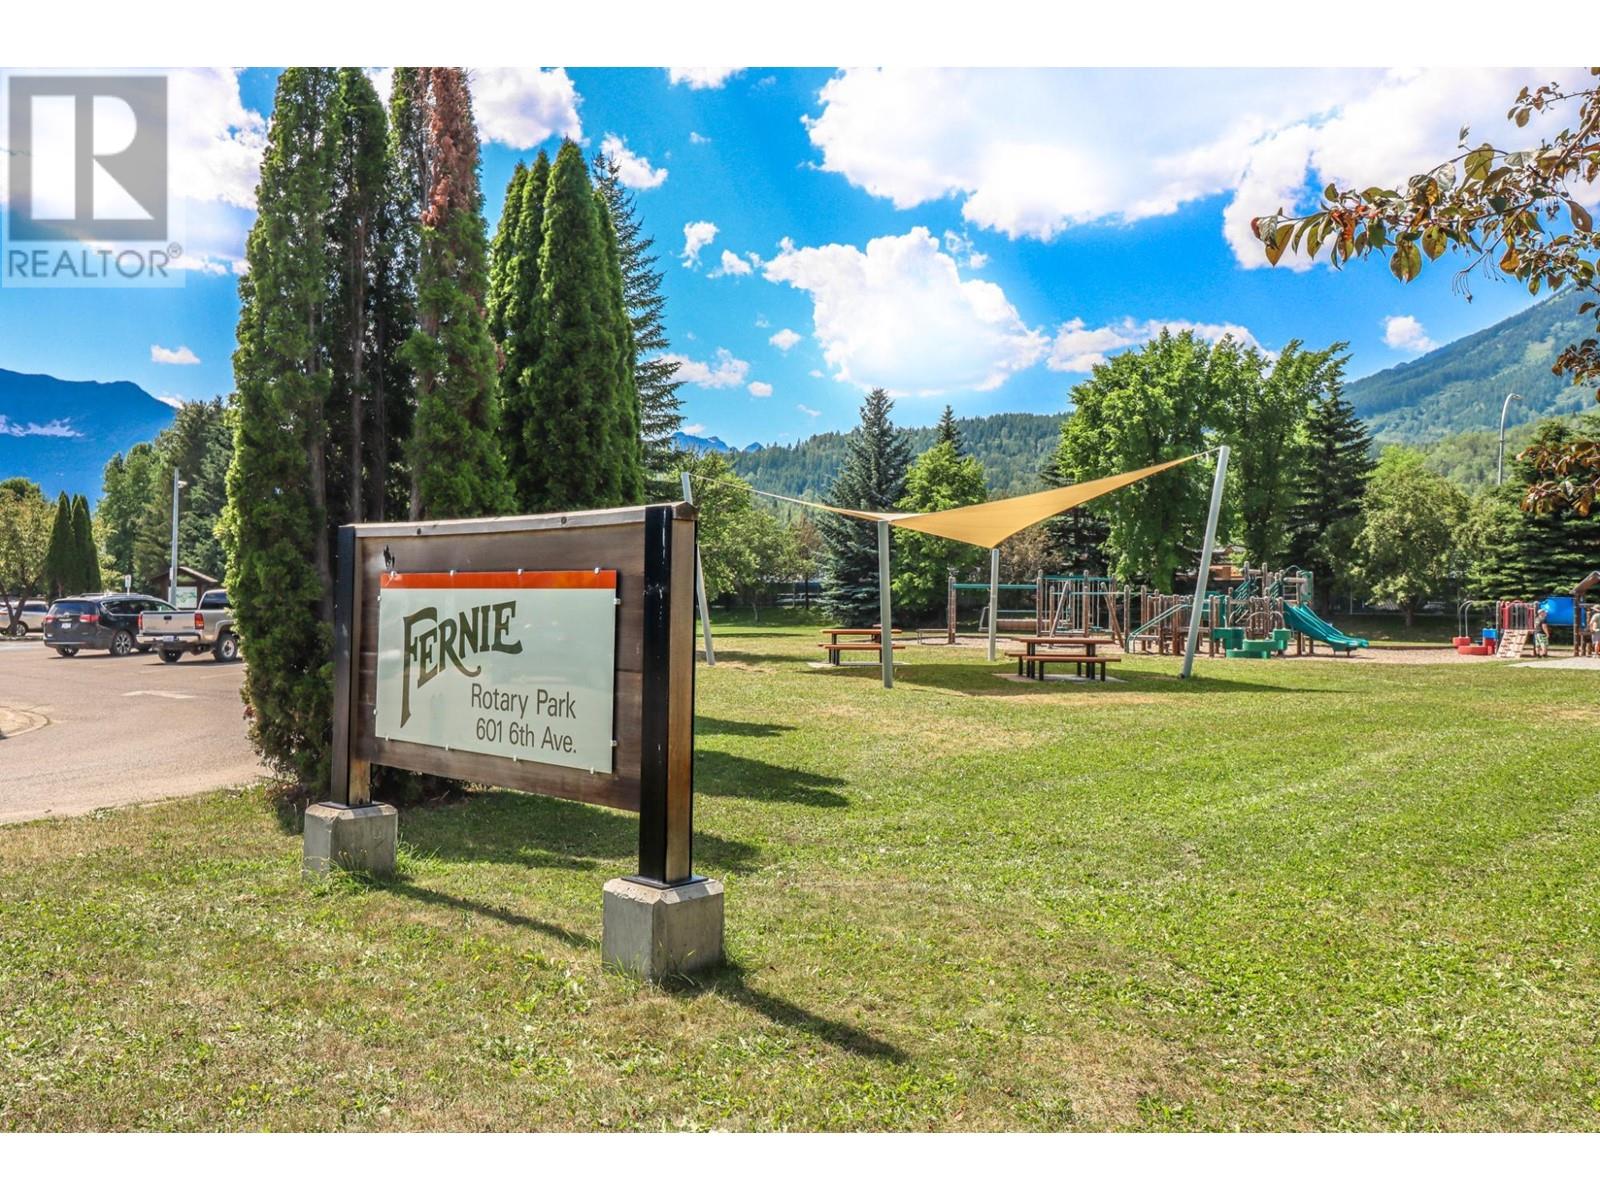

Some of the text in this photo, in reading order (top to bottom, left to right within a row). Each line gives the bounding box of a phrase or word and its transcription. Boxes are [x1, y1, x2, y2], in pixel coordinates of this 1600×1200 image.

[400, 600, 523, 728] FERNIE
[471, 683, 577, 719] Rotary Park
[476, 717, 577, 753] 601 6th Ave.
